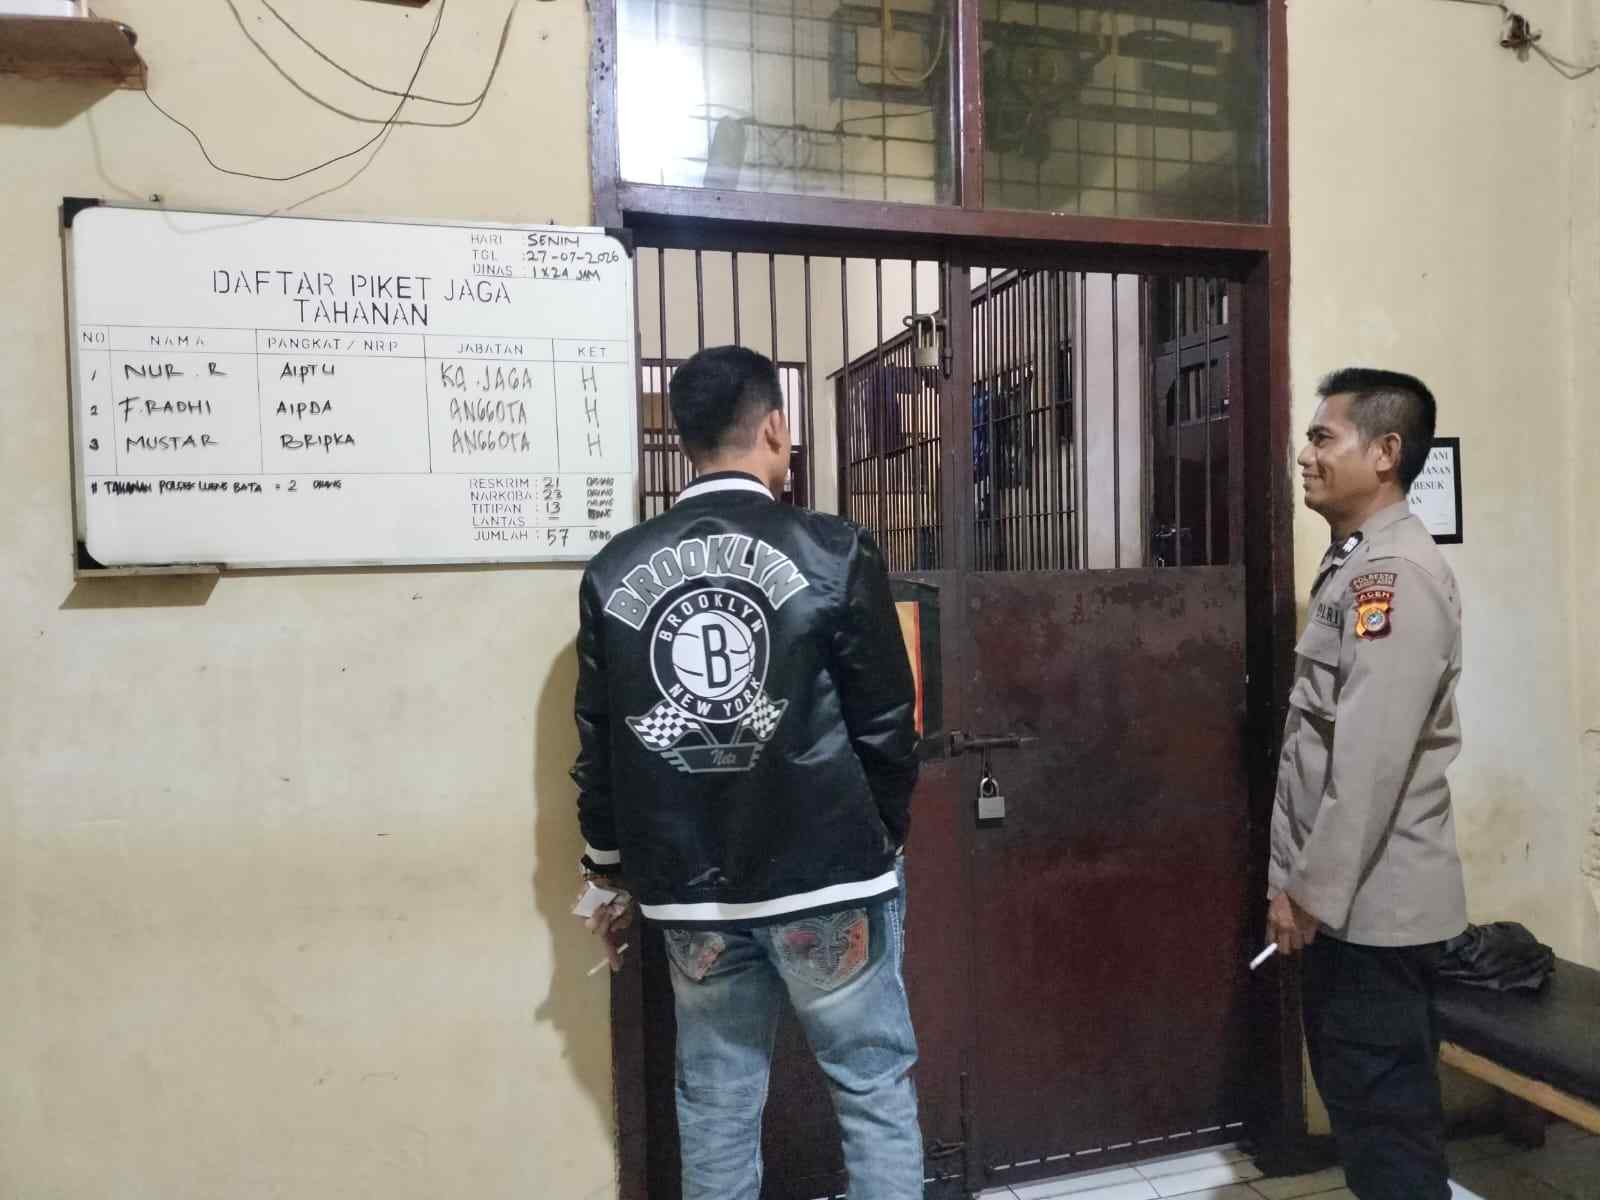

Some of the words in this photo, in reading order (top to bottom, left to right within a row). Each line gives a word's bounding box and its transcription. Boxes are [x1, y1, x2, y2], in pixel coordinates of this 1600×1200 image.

[471, 233, 503, 245] HARI
[527, 233, 580, 248] SENIN
[473, 264, 513, 276] DINAS
[213, 270, 334, 297] DAFTAR
[351, 274, 432, 301] PIKET
[444, 281, 512, 304] JAGA
[293, 298, 429, 326] TAHANAN
[82, 332, 105, 344] NO
[151, 335, 207, 345] NAMA
[268, 337, 341, 349] PANGKAT
[364, 340, 399, 352] NRP
[457, 343, 524, 355] JABATAN
[577, 347, 608, 357] KET
[581, 366, 598, 391] H
[89, 405, 98, 416] 2
[450, 398, 527, 424] ANGGOTA
[584, 397, 600, 428] H
[89, 439, 99, 450] 3
[126, 434, 219, 453] MUSTAR
[452, 429, 531, 454] ANGGOTA
[587, 432, 603, 457] H
[233, 481, 262, 493] BATA
[287, 479, 297, 493] 2
[469, 478, 529, 489] RESKRIM
[543, 477, 560, 489] 21
[1414, 480, 1444, 491] BESUK
[470, 491, 532, 501] NARKOBA
[543, 489, 562, 500] 23
[472, 503, 521, 514] TITIPAN
[546, 502, 561, 514] 13
[472, 516, 526, 527] LANTAS
[473, 531, 528, 541] JUMLAH
[547, 529, 568, 547] 57
[604, 533, 810, 631] BROOKLYN
[659, 593, 764, 642] BROOKLYN
[702, 623, 731, 689] B
[668, 683, 713, 717] NEW
[723, 679, 761, 717] YORK
